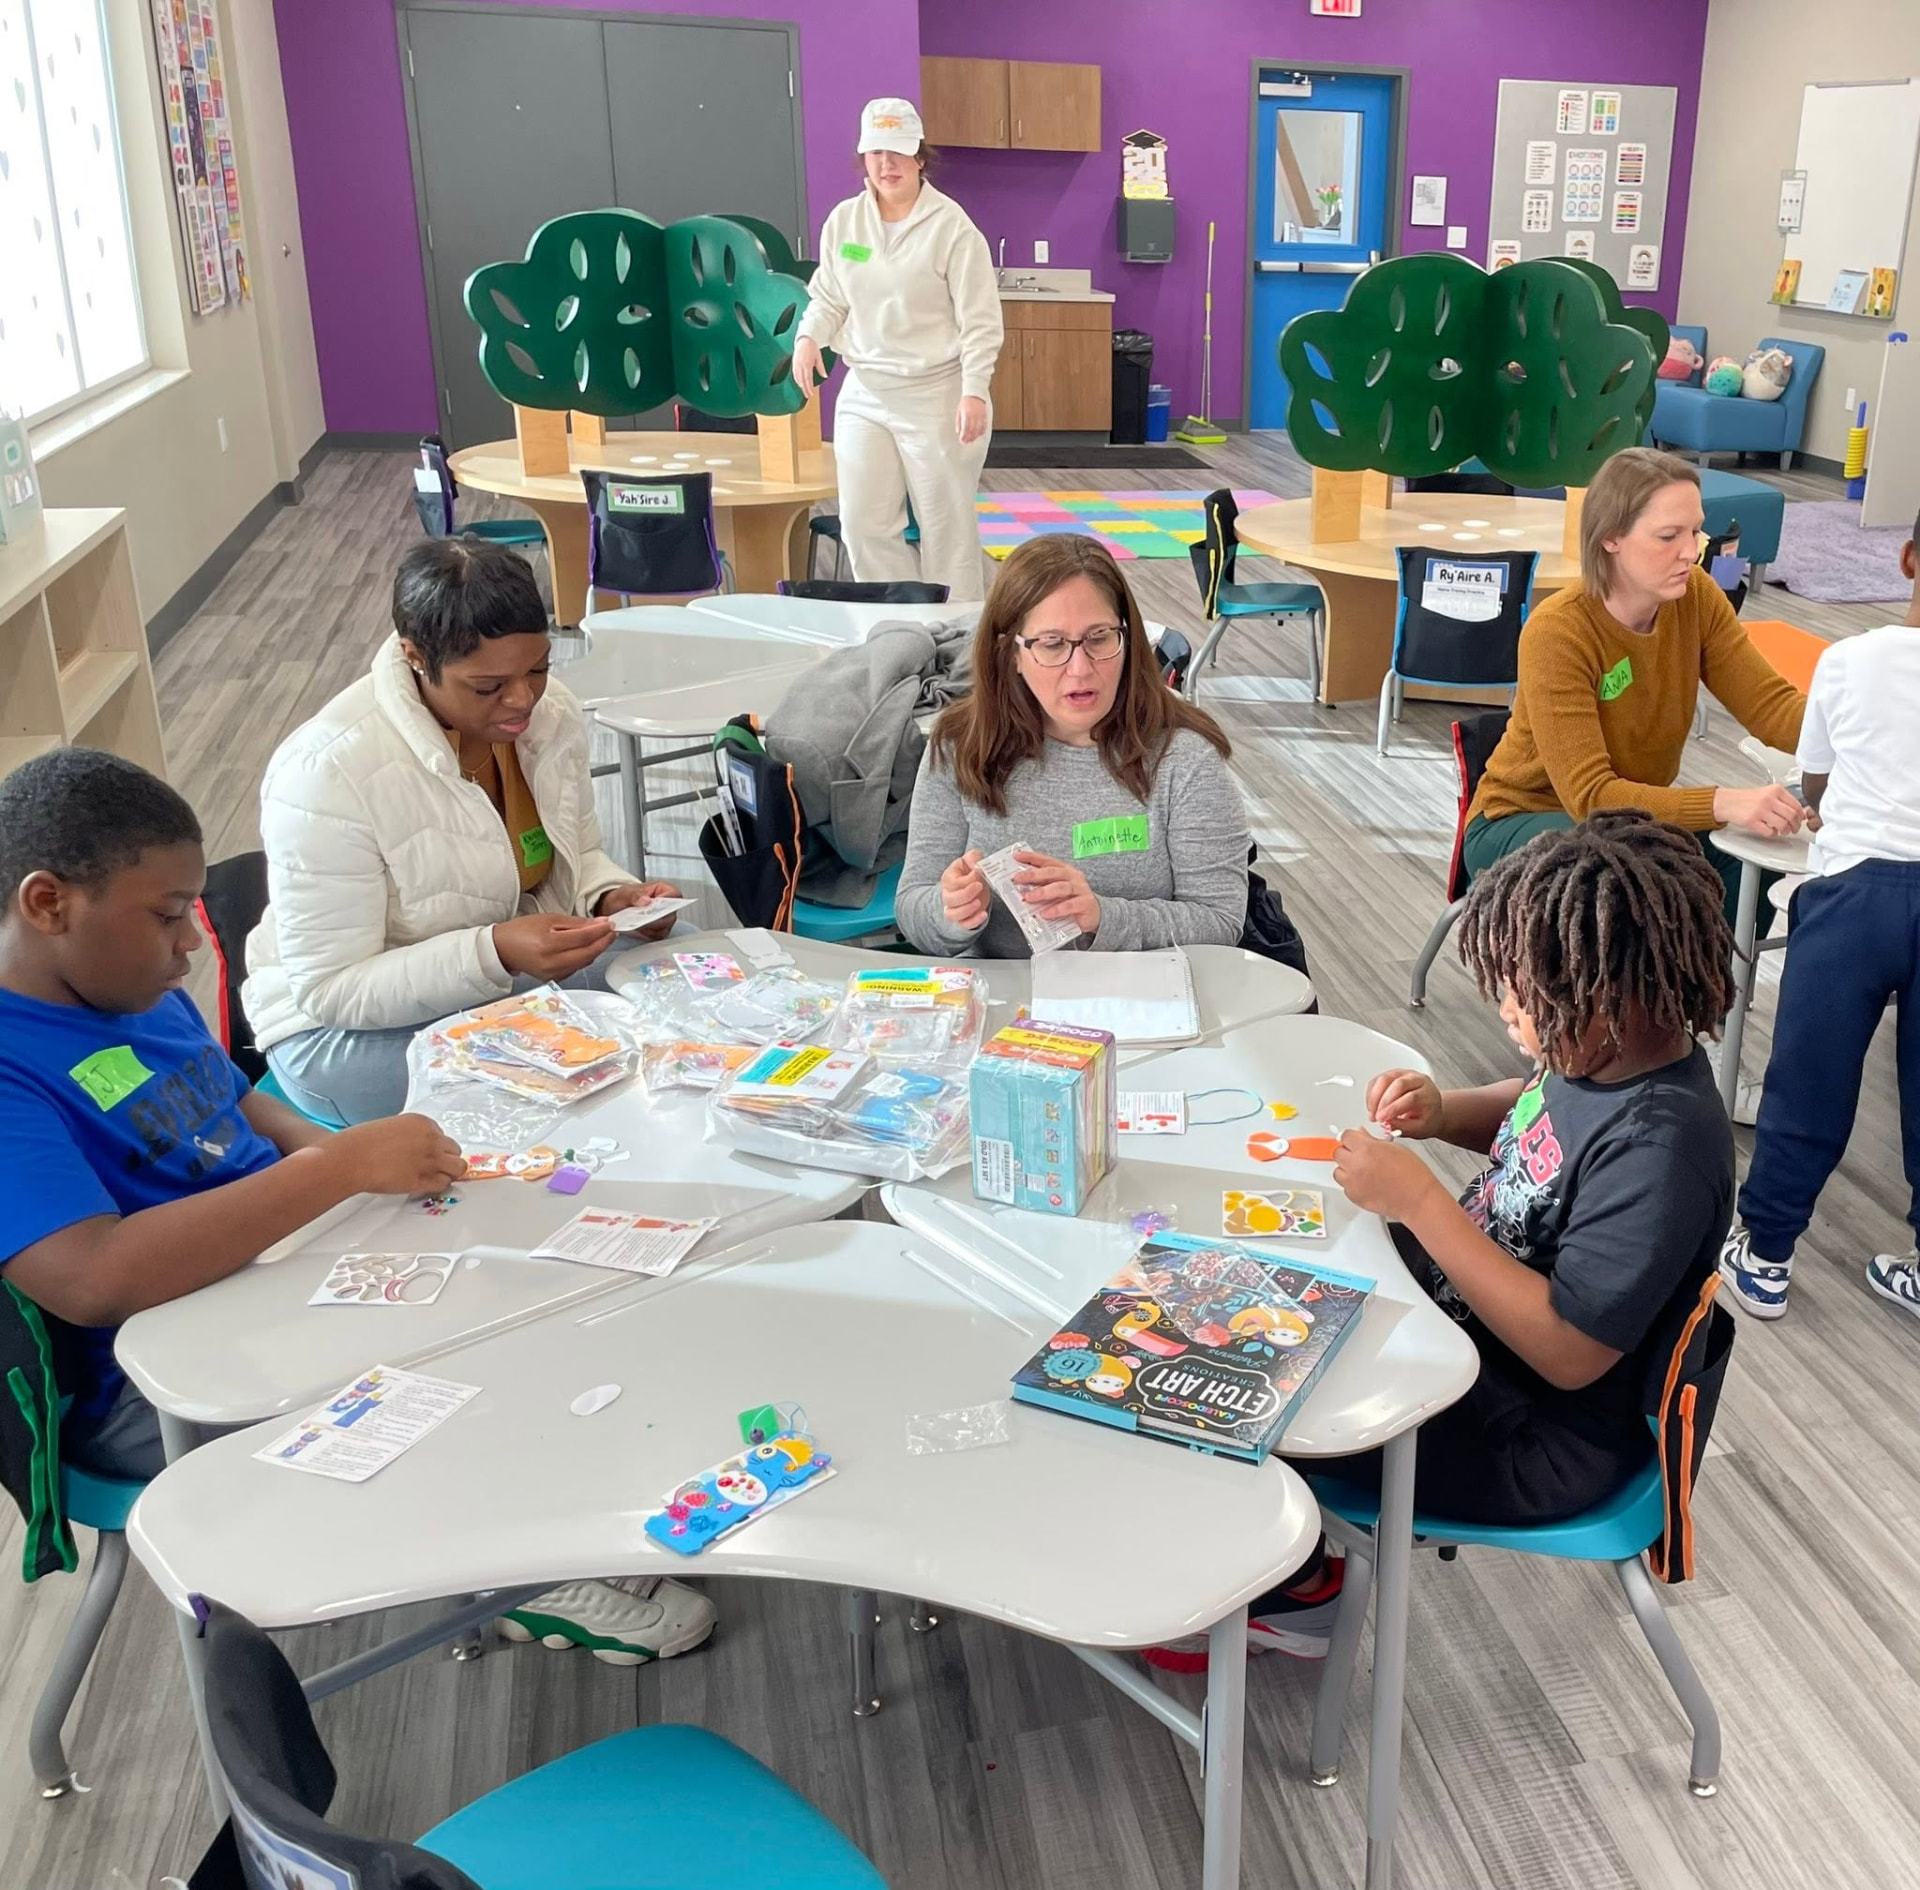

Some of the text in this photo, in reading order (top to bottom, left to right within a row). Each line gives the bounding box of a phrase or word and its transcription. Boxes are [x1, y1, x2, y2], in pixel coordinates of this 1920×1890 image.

[619, 492, 660, 505] Yah'Sire
[1439, 568, 1495, 583] Ry'Aire A.
[1079, 827, 1142, 851] Antoinette
[1058, 1358, 1086, 1373] 16
[1183, 1364, 1256, 1387] CREATIONS
[1145, 1368, 1271, 1416] ETCH ART
[1154, 1393, 1238, 1420] KALEIDOSCOPE
